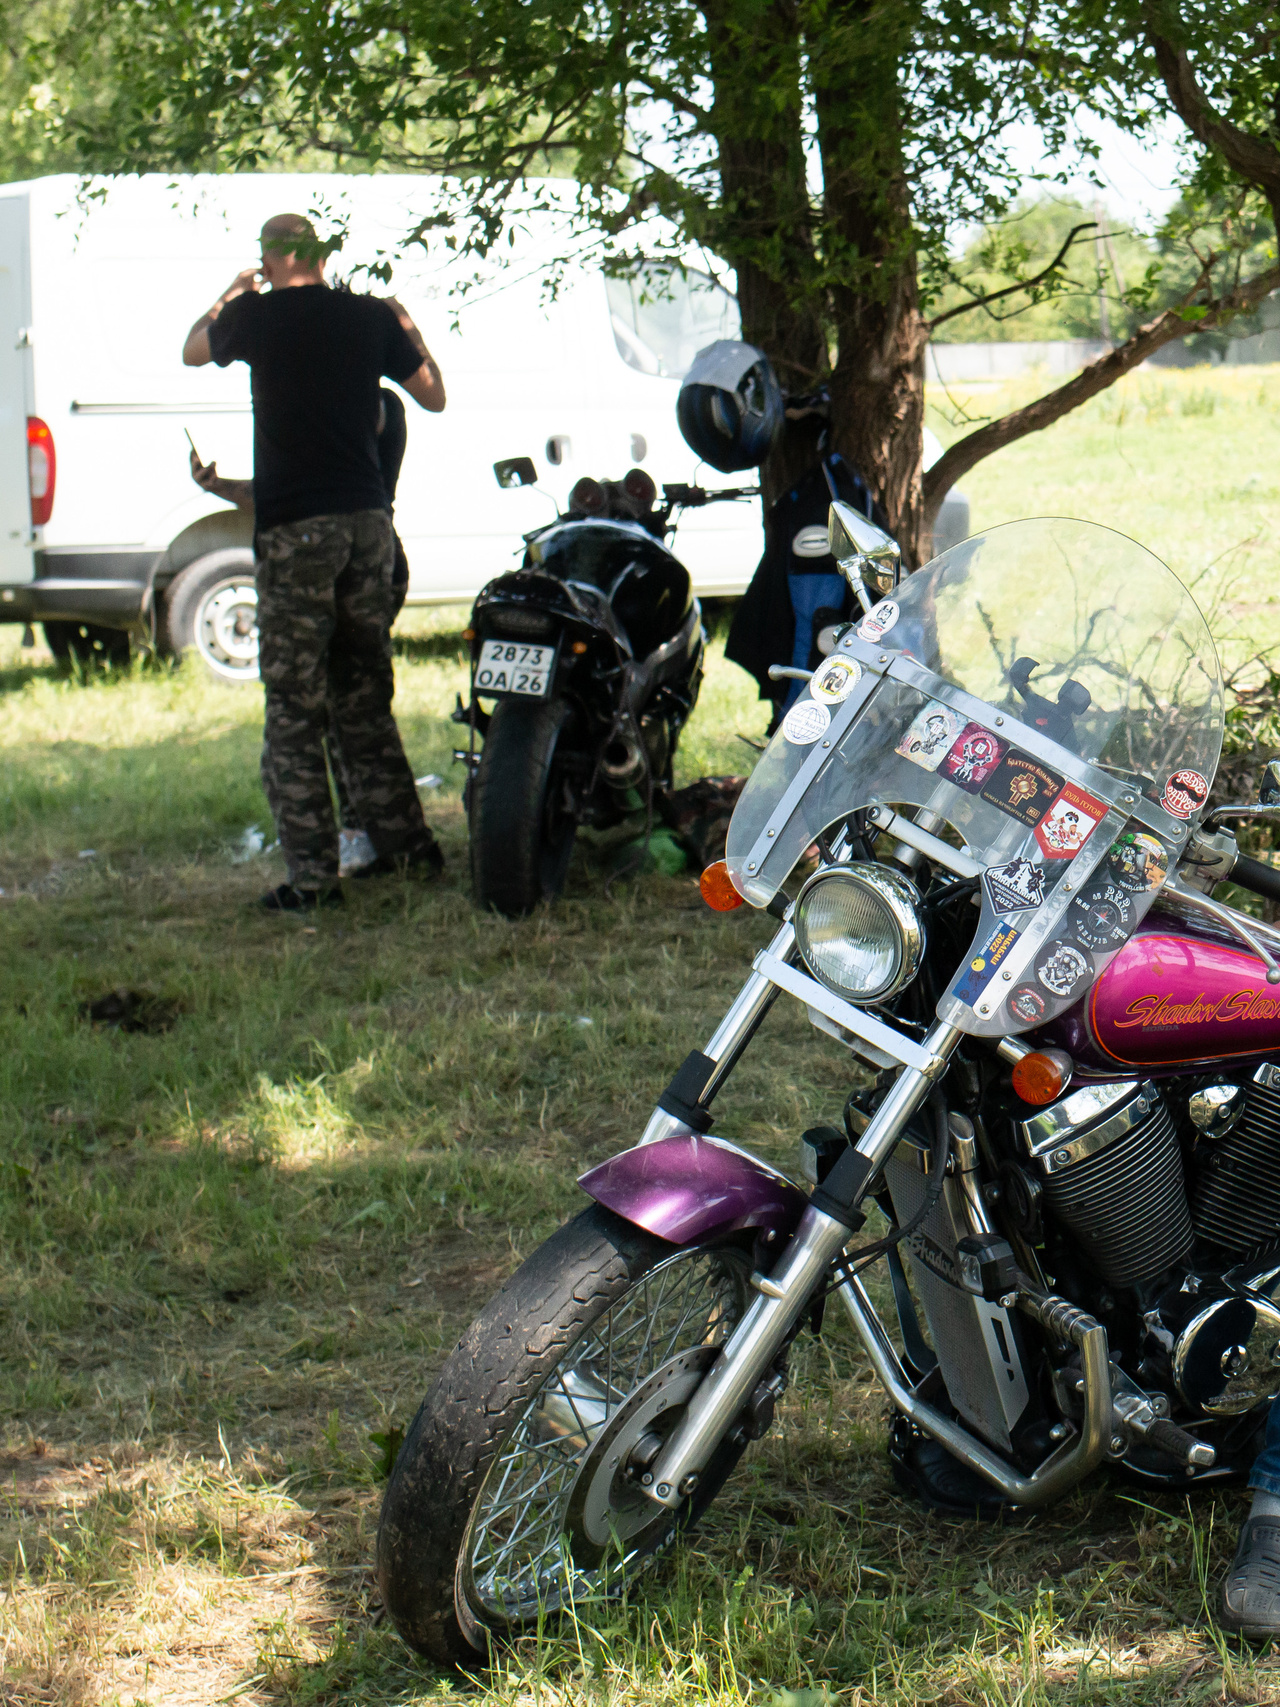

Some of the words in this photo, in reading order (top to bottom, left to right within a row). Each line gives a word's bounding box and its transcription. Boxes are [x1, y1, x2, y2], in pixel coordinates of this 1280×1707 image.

[491, 645, 543, 665] 2873
[517, 674, 541, 693] 26
[1064, 789, 1080, 804] БУДЬ
[1079, 801, 1104, 818] ГОТОВ!
[995, 894, 1014, 910] 2022
[988, 932, 1006, 953] 2022
[1113, 926, 1129, 940] 2022
[990, 929, 1018, 966] ШАБАБАШ
[1113, 993, 1230, 1028] Shadow
[1141, 1024, 1180, 1033] HONDA
